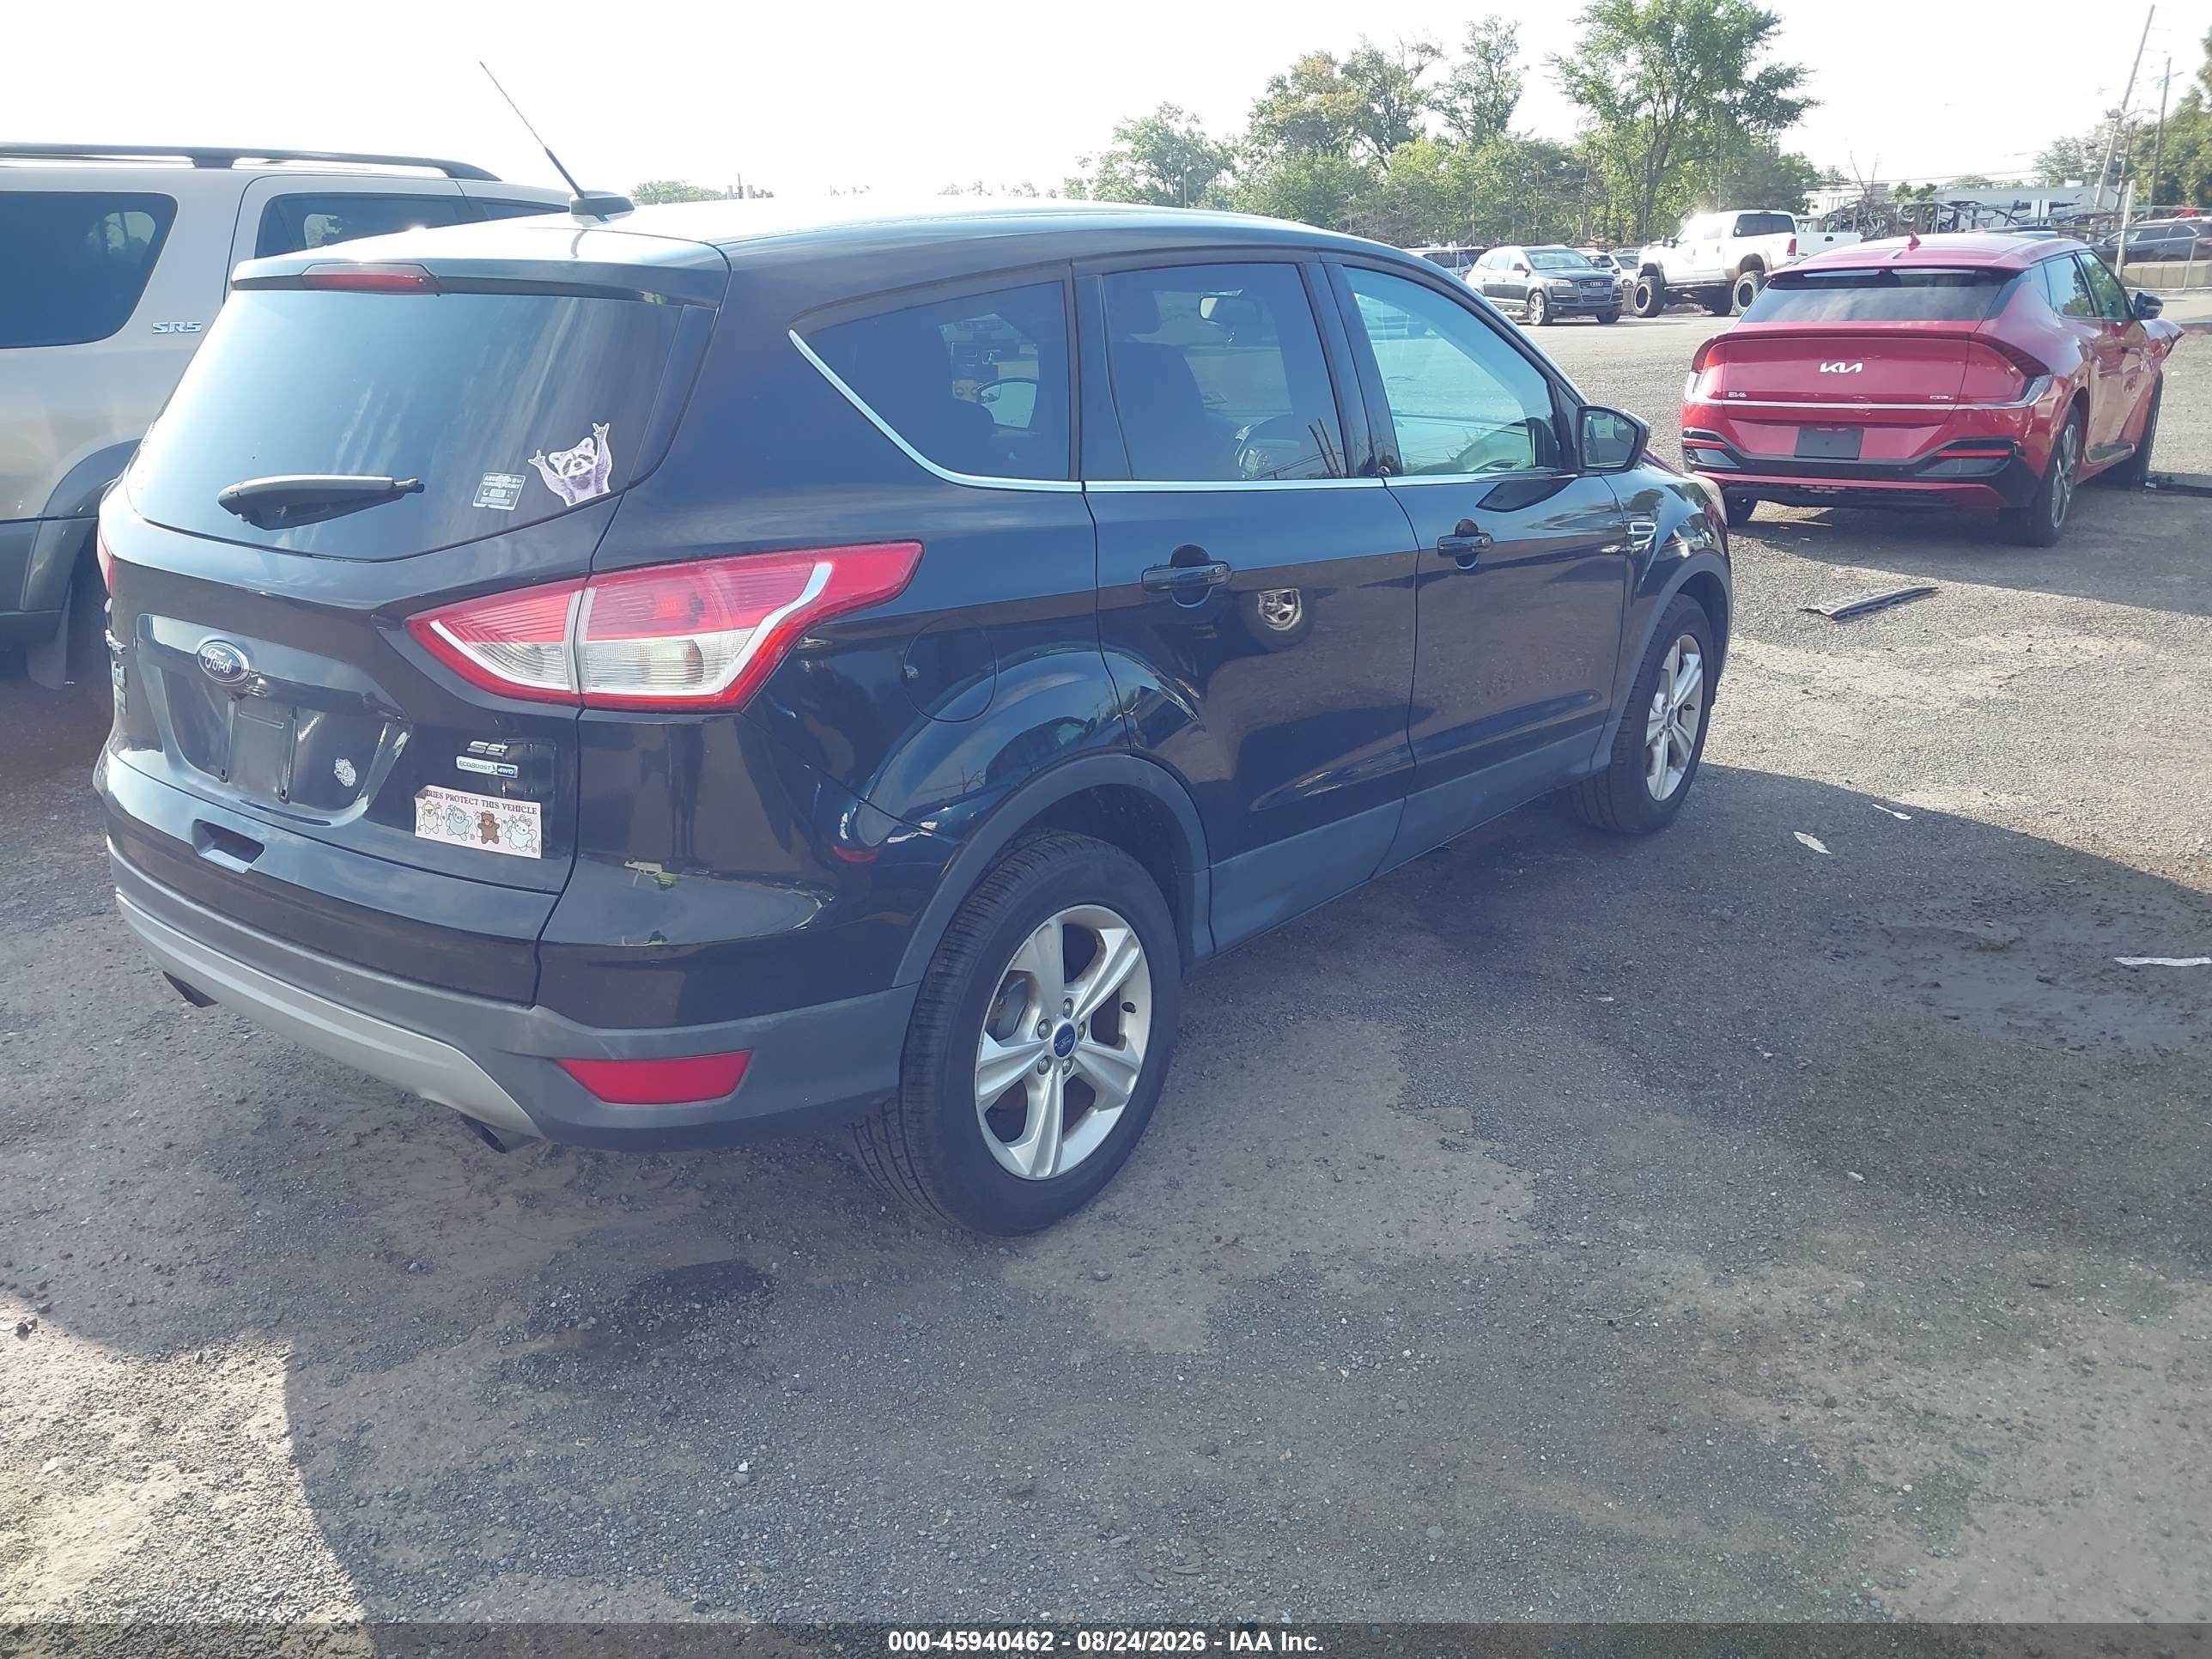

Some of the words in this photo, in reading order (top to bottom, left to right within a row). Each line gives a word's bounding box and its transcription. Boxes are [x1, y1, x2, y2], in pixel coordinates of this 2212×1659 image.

[151, 321, 202, 334] SR5
[204, 647, 233, 674] Ford
[467, 741, 508, 756] SE
[497, 767, 514, 775] 4WD
[445, 793, 480, 805] PROTECT
[481, 799, 500, 810] THIS
[501, 803, 538, 815] VEHICLE
